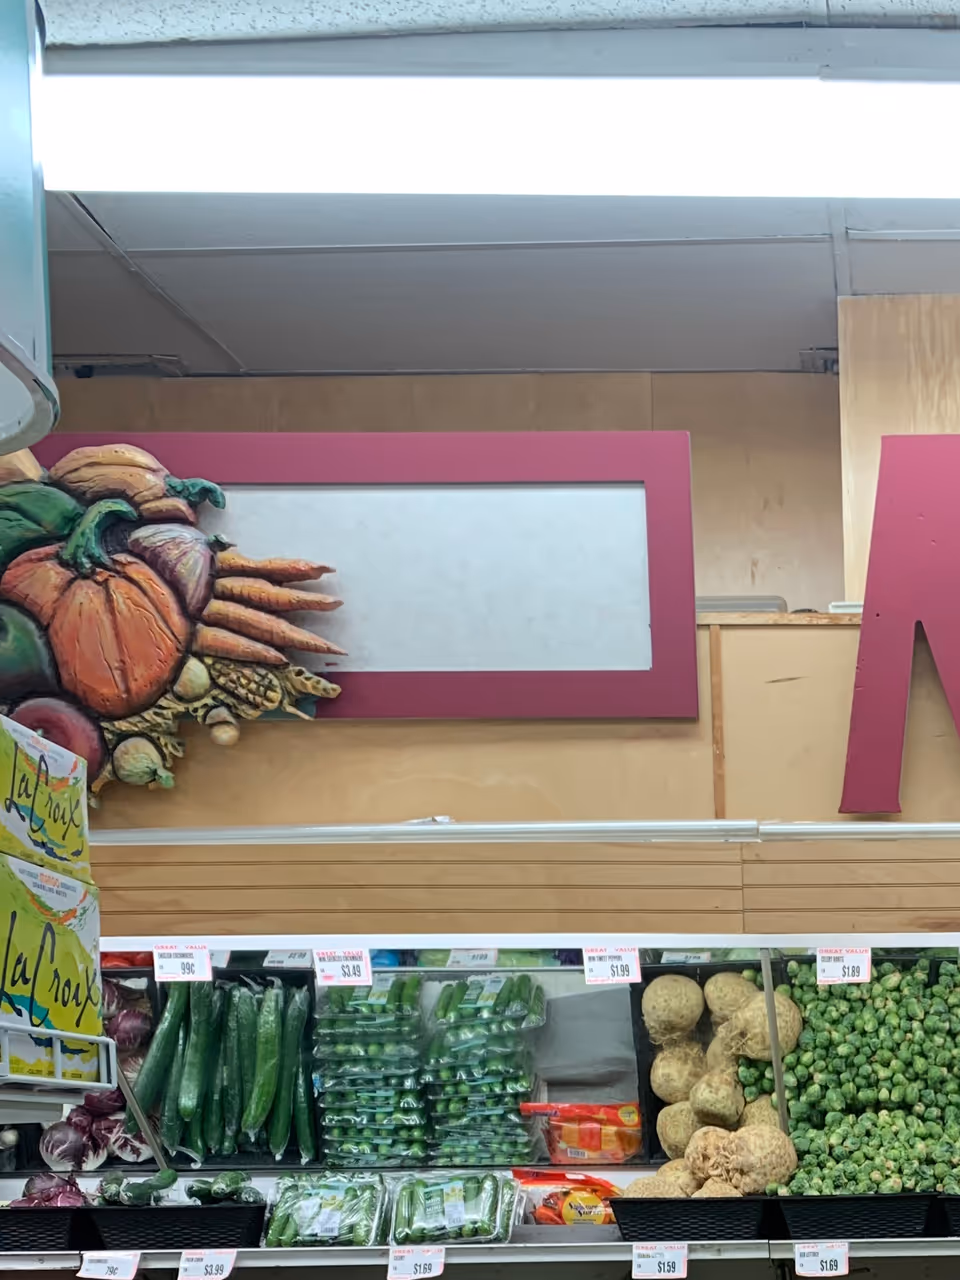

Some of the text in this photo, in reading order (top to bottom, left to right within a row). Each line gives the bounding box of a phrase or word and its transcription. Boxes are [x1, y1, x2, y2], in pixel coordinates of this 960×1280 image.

[341, 963, 361, 978] $3.49
[610, 964, 630, 977] $1.99
[842, 965, 860, 978] $1.89
[204, 1263, 224, 1276] $3.99
[413, 1262, 432, 1275] $1.69
[657, 1261, 676, 1273] $1.59
[820, 1259, 838, 1272] $1.69
